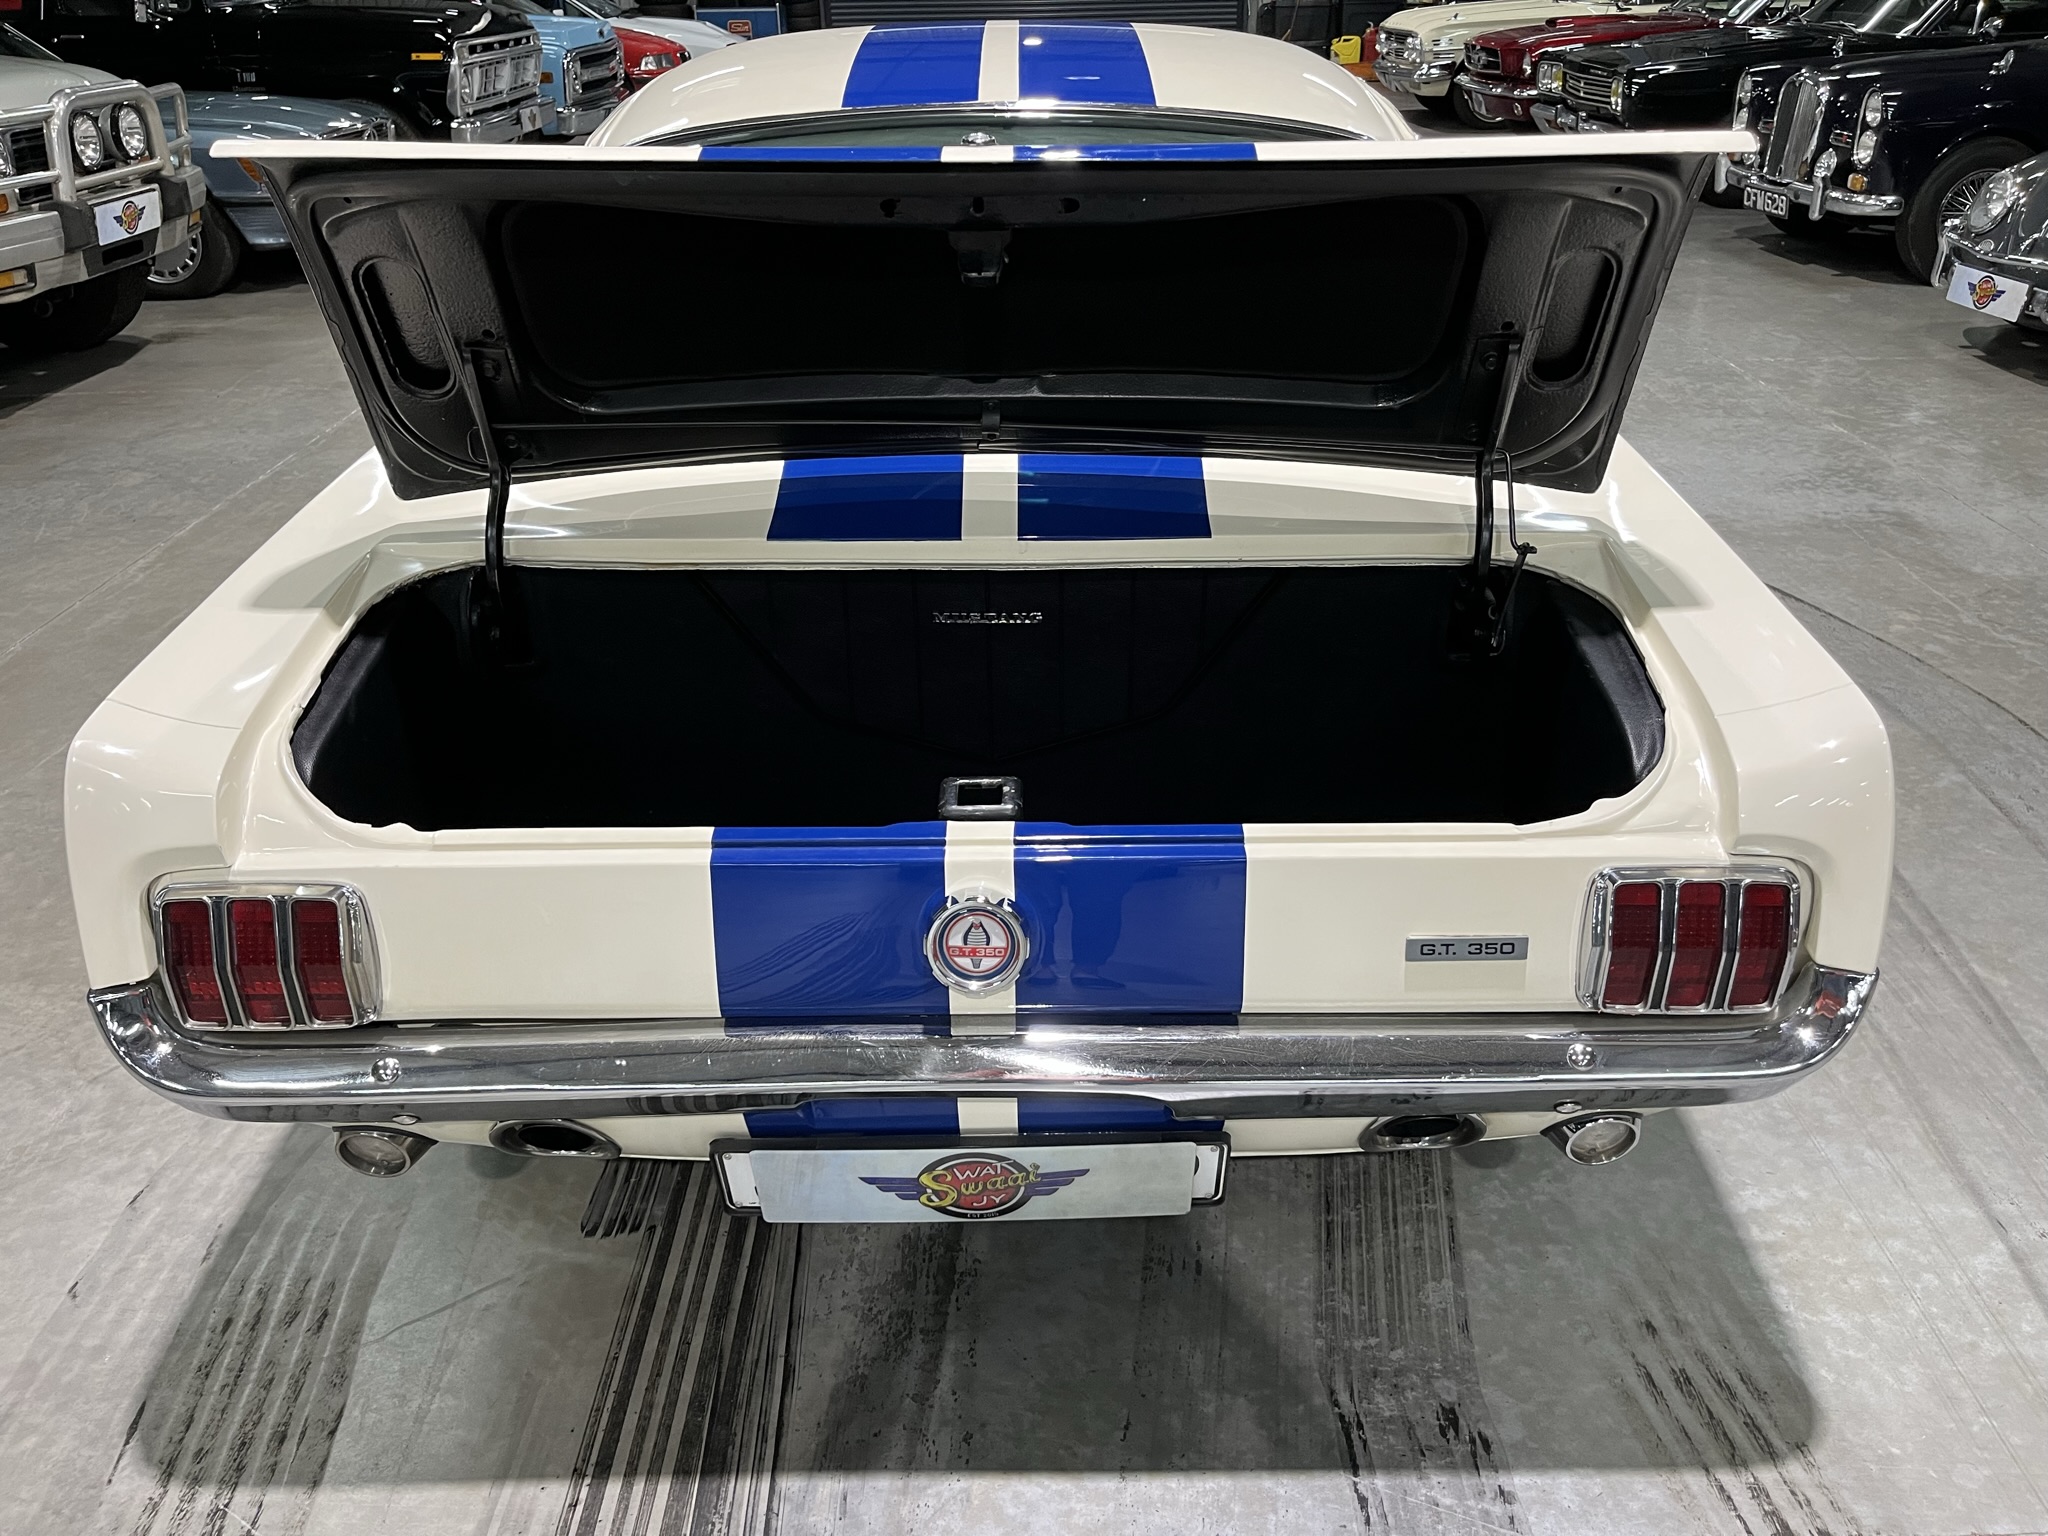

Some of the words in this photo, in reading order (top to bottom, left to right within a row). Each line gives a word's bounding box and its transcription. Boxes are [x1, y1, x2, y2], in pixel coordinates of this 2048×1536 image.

[949, 947, 973, 957] G.T.
[975, 948, 1005, 957] 350
[1420, 943, 1457, 956] G.T.
[1467, 942, 1515, 955] 350
[953, 1160, 1014, 1180] WAT
[972, 1193, 1007, 1206] JY
